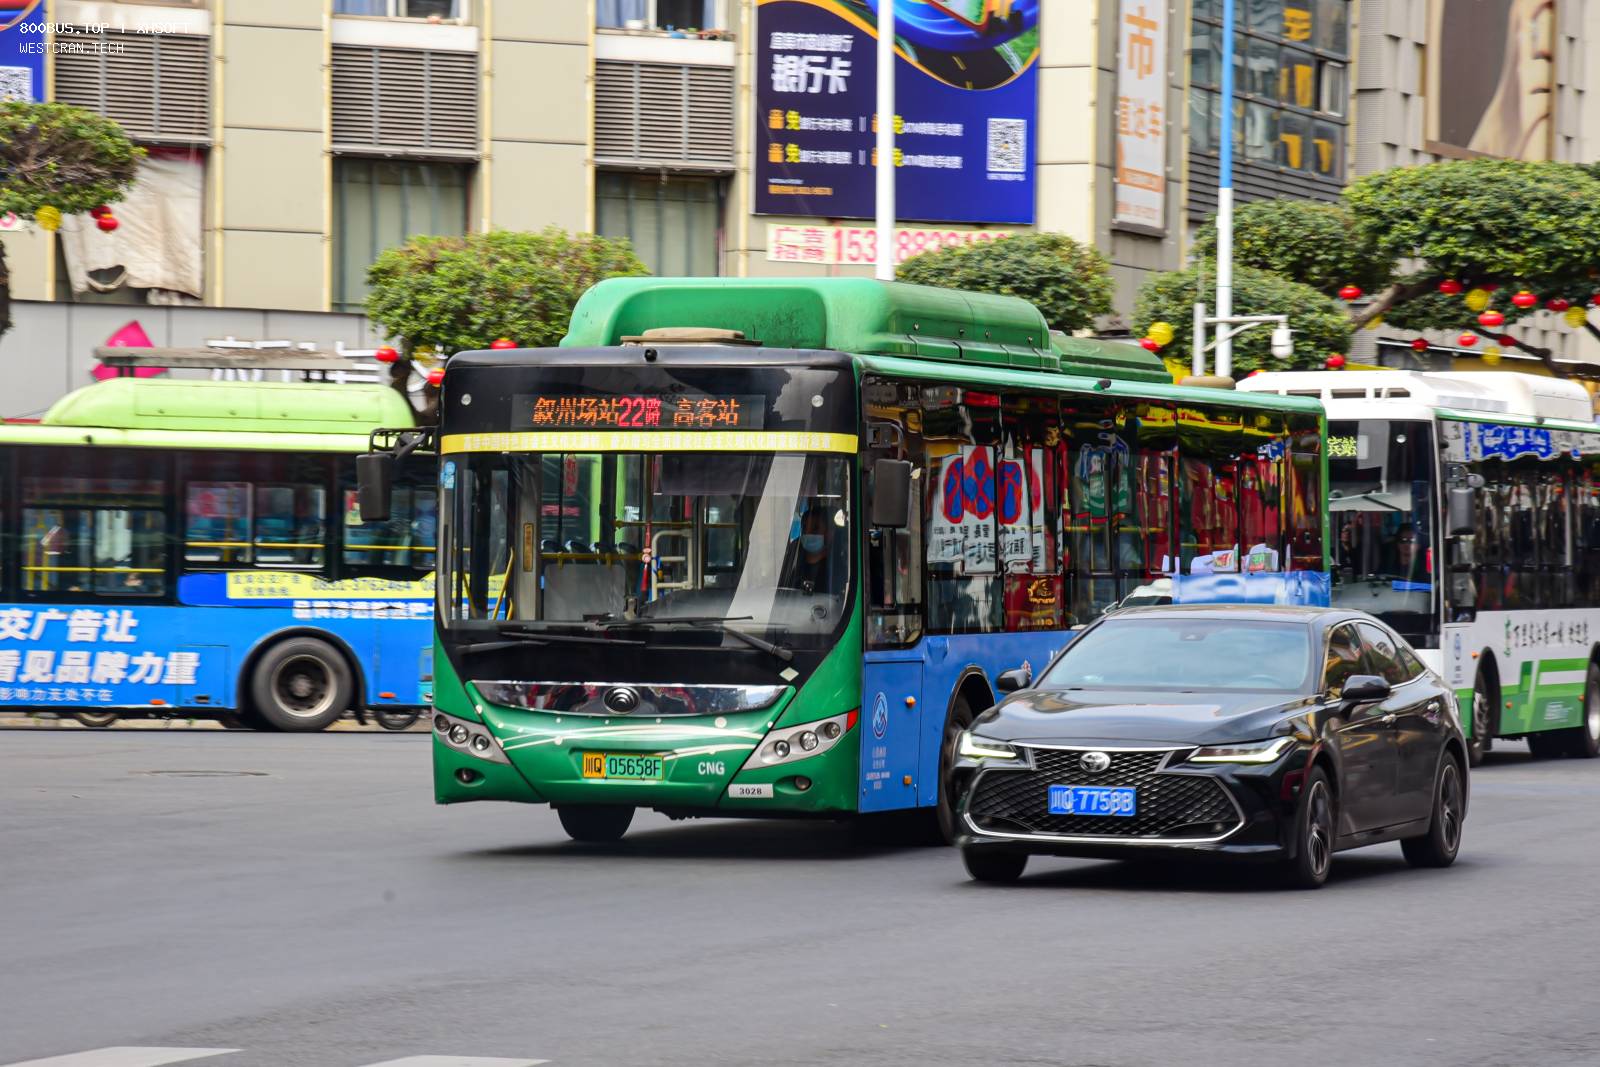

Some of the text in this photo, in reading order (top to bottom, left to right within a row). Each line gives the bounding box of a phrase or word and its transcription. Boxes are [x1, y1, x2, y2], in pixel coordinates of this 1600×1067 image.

[771, 54, 852, 94] 银行卡
[775, 226, 825, 244] 广告
[775, 244, 825, 261] 招商
[674, 398, 740, 427] 高客站
[0, 607, 139, 642] 交广告让
[697, 760, 726, 776] CNG
[738, 787, 763, 796] 3028
